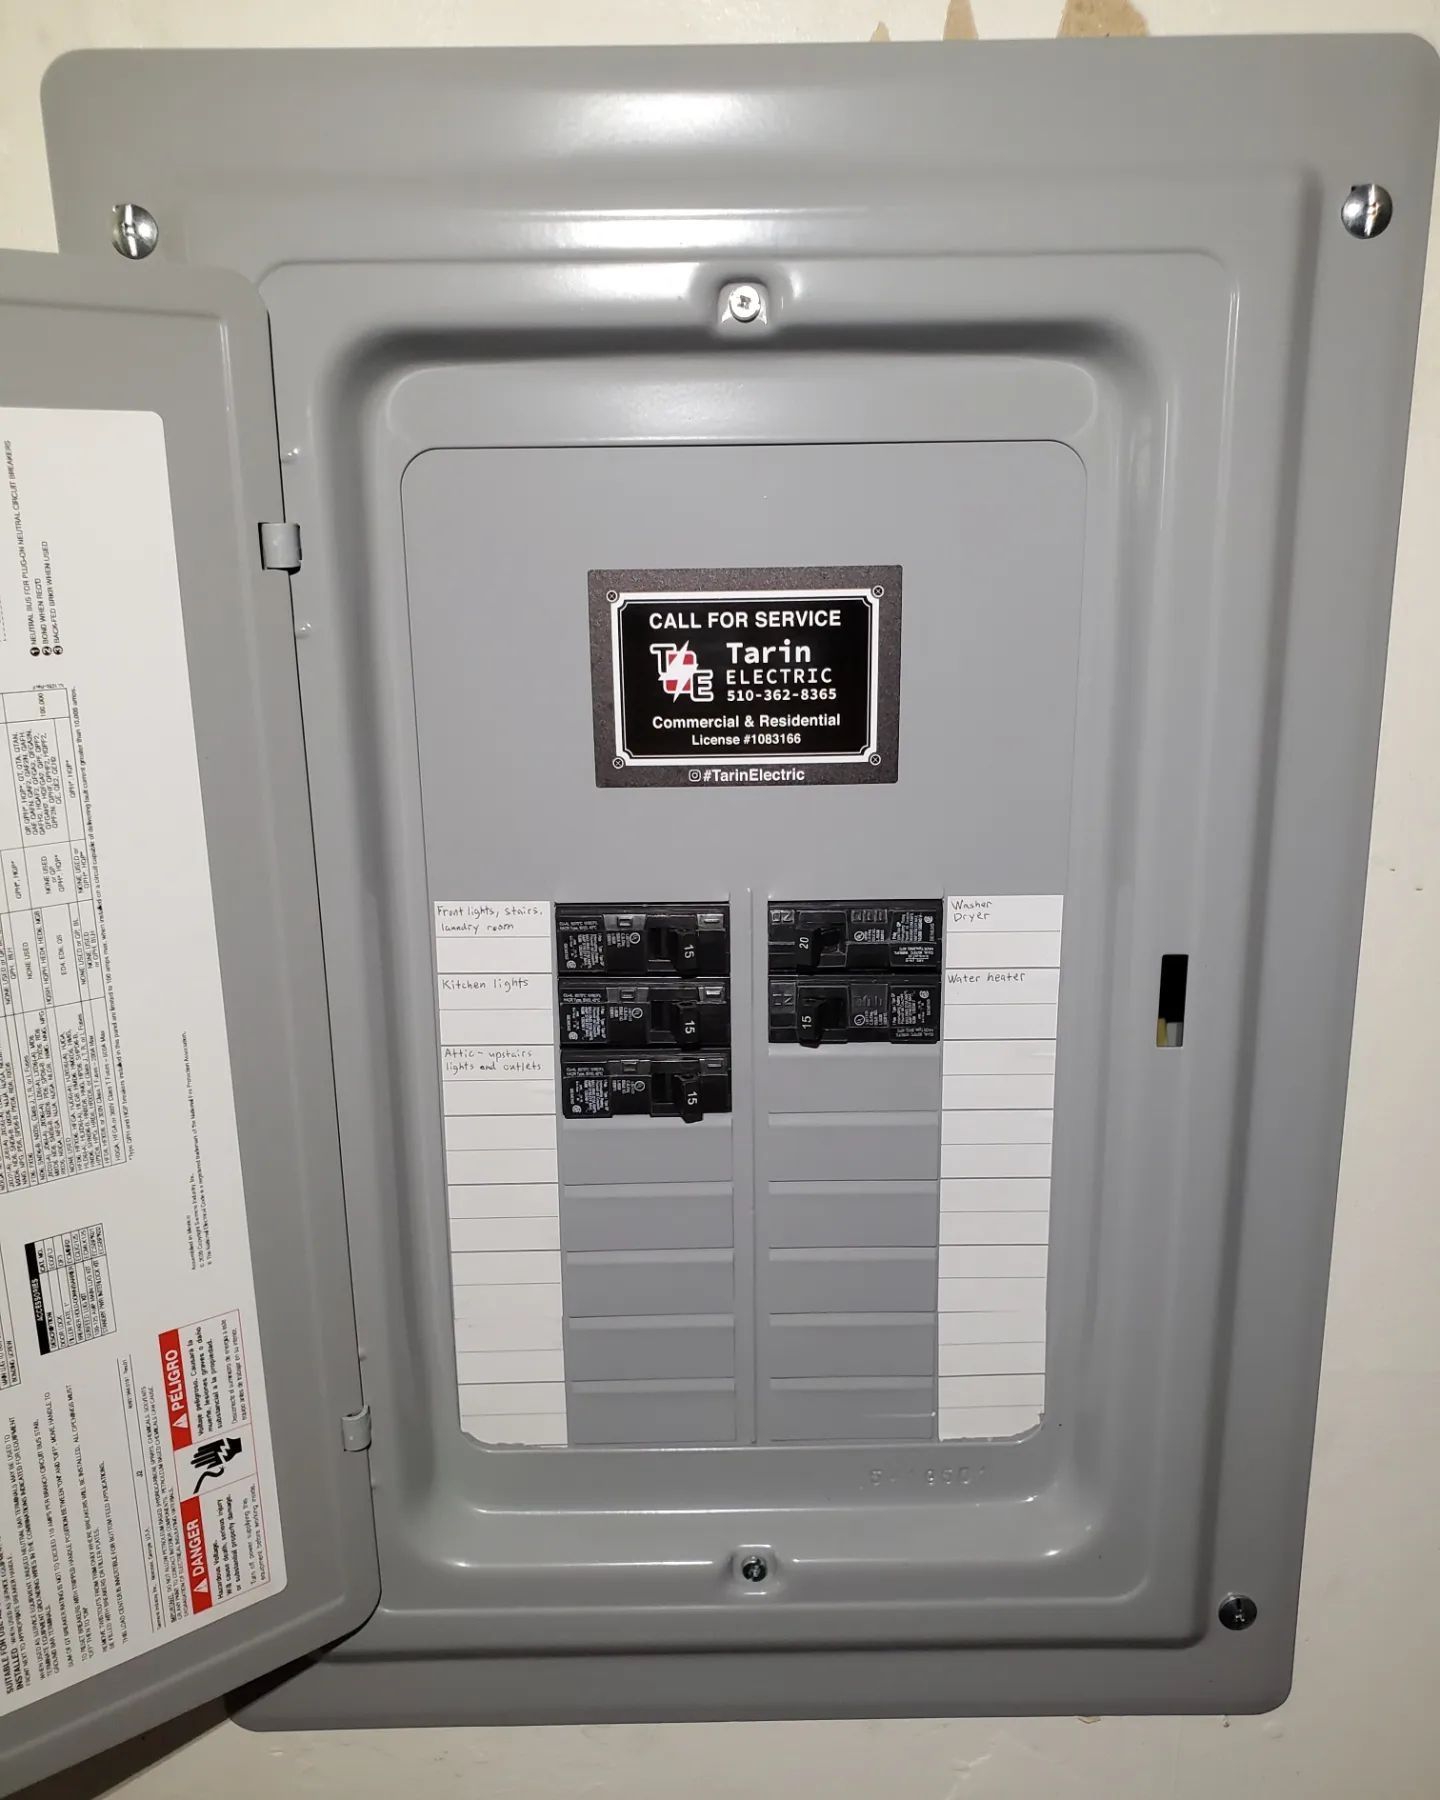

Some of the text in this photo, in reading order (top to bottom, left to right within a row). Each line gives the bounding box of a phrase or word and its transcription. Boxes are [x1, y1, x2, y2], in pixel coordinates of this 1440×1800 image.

[9, 481, 20, 510] CIRCUIT
[14, 512, 24, 545] NEUTRAL
[41, 541, 50, 562] USED
[44, 563, 52, 585] WHEN
[23, 580, 31, 595] FOR
[25, 596, 33, 611] BUS
[37, 601, 46, 623] WHEN
[650, 610, 841, 629] CALL FOR SERVICE
[28, 614, 37, 645] NEUTRAL
[726, 638, 811, 664] Tarin
[726, 668, 832, 684] ELECTRIC
[727, 688, 837, 702] 510-362-8365
[652, 713, 841, 729] Commercial & Residential
[692, 733, 801, 746] License #1083166
[703, 768, 805, 782] #TarinElectric
[437, 906, 463, 916] Front
[951, 899, 993, 910] Washer
[954, 912, 990, 922] Dryer
[487, 924, 514, 932] room
[800, 936, 810, 950] 20
[684, 944, 694, 959] 15
[442, 978, 529, 992] Kitchen lights
[948, 972, 1026, 984] Water heater
[685, 1020, 696, 1034] 15
[802, 1016, 812, 1030] 15
[446, 1062, 474, 1075] lights
[504, 1062, 542, 1071] outlets
[687, 1092, 698, 1106] 15
[187, 1519, 204, 1577] DANGER
[1, 1656, 14, 1694] SUITABLE
[11, 1648, 24, 1690] INSTALLED
